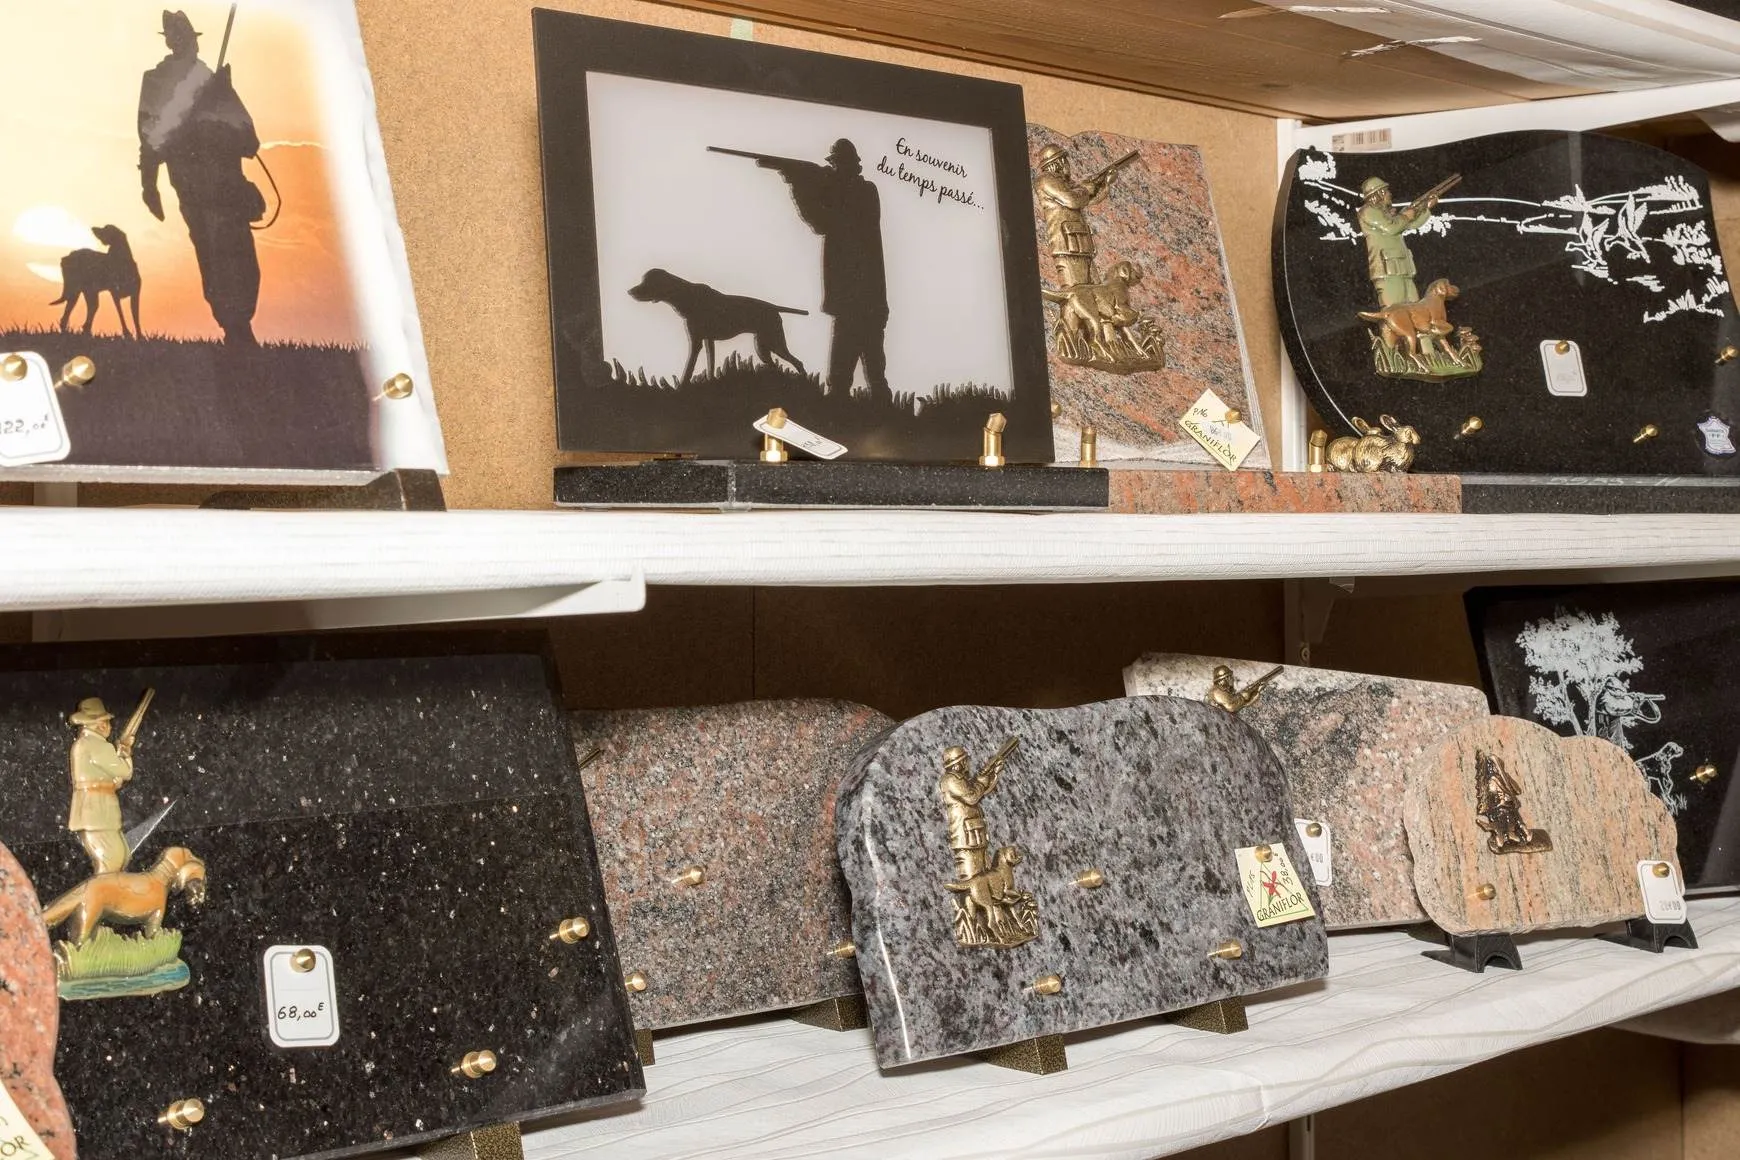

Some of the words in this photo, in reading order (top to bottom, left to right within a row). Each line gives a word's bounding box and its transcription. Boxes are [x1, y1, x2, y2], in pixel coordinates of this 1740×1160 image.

[876, 155, 896, 177] du
[898, 163, 938, 197] temps
[895, 137, 914, 156] En
[915, 150, 968, 178] souvenir
[1184, 420, 1237, 461] GRANIFLOR
[1256, 892, 1305, 921] GRANIFLOR
